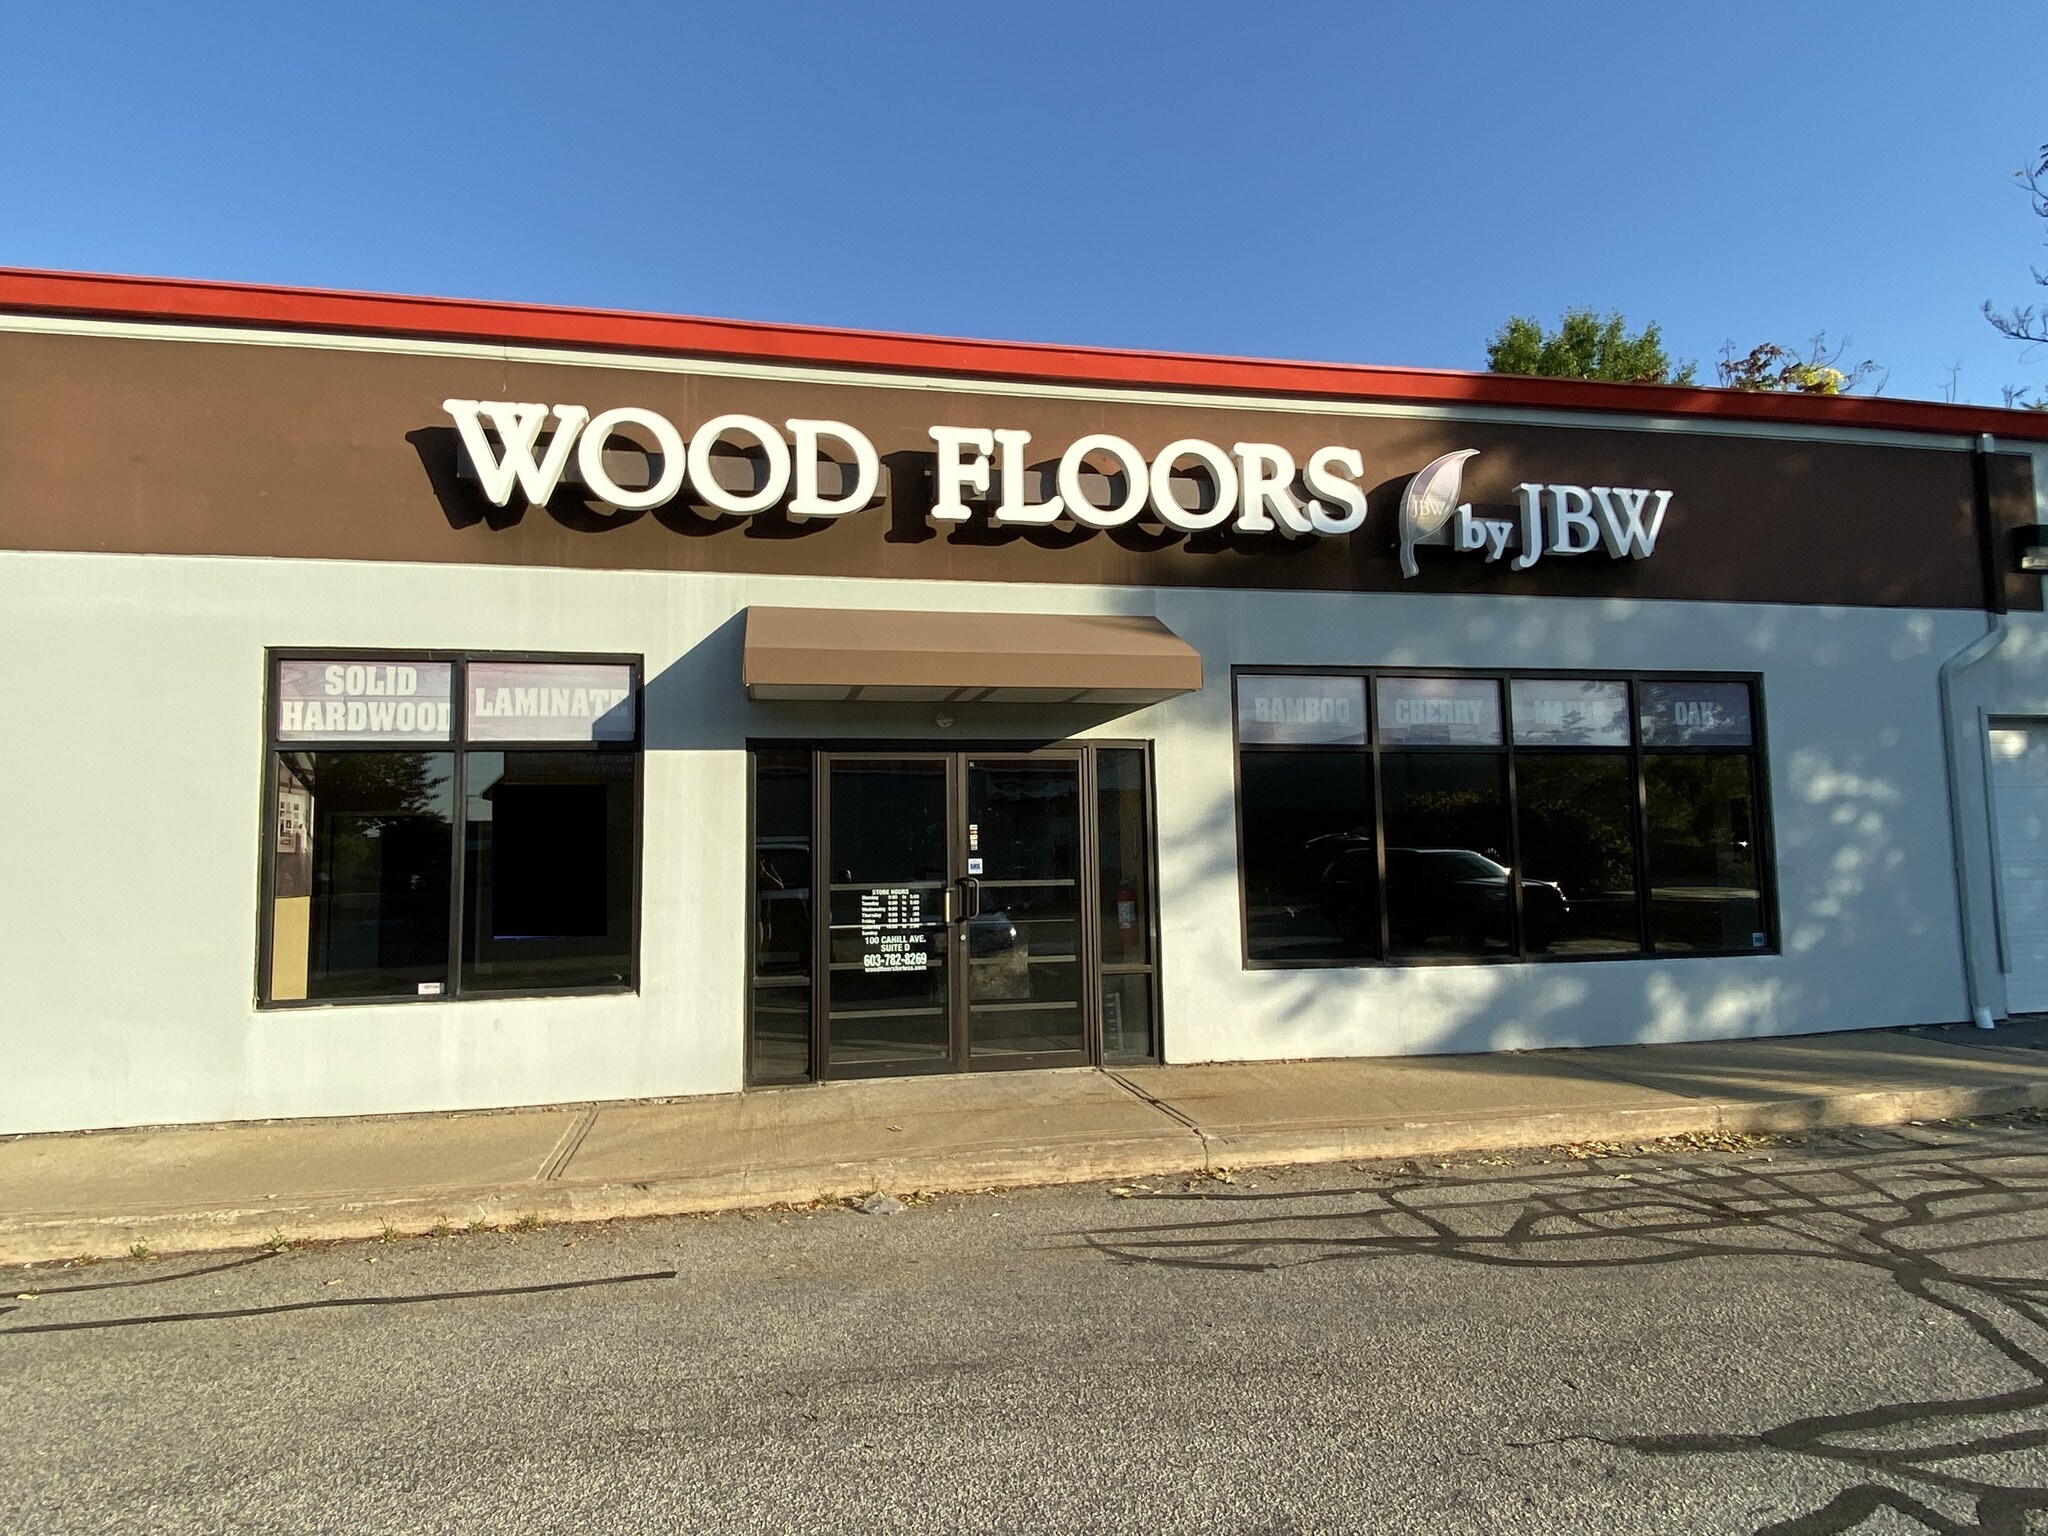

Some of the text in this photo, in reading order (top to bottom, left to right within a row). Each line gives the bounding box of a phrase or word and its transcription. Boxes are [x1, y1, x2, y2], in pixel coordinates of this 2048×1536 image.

[442, 398, 1369, 537] WOOD FLOORS
[1412, 499, 1446, 518] JBW
[1456, 483, 1674, 571] by JBW
[324, 664, 418, 697] SOLID
[474, 687, 630, 717] LAMINATE
[1254, 697, 1351, 725] BAMBOO
[1395, 699, 1484, 725] CHERRY
[1674, 700, 1715, 726] OAK
[865, 934, 927, 944] 100 CAHILL AVE.
[880, 943, 911, 952] SUITE D
[864, 952, 927, 966] 603-782-8269
